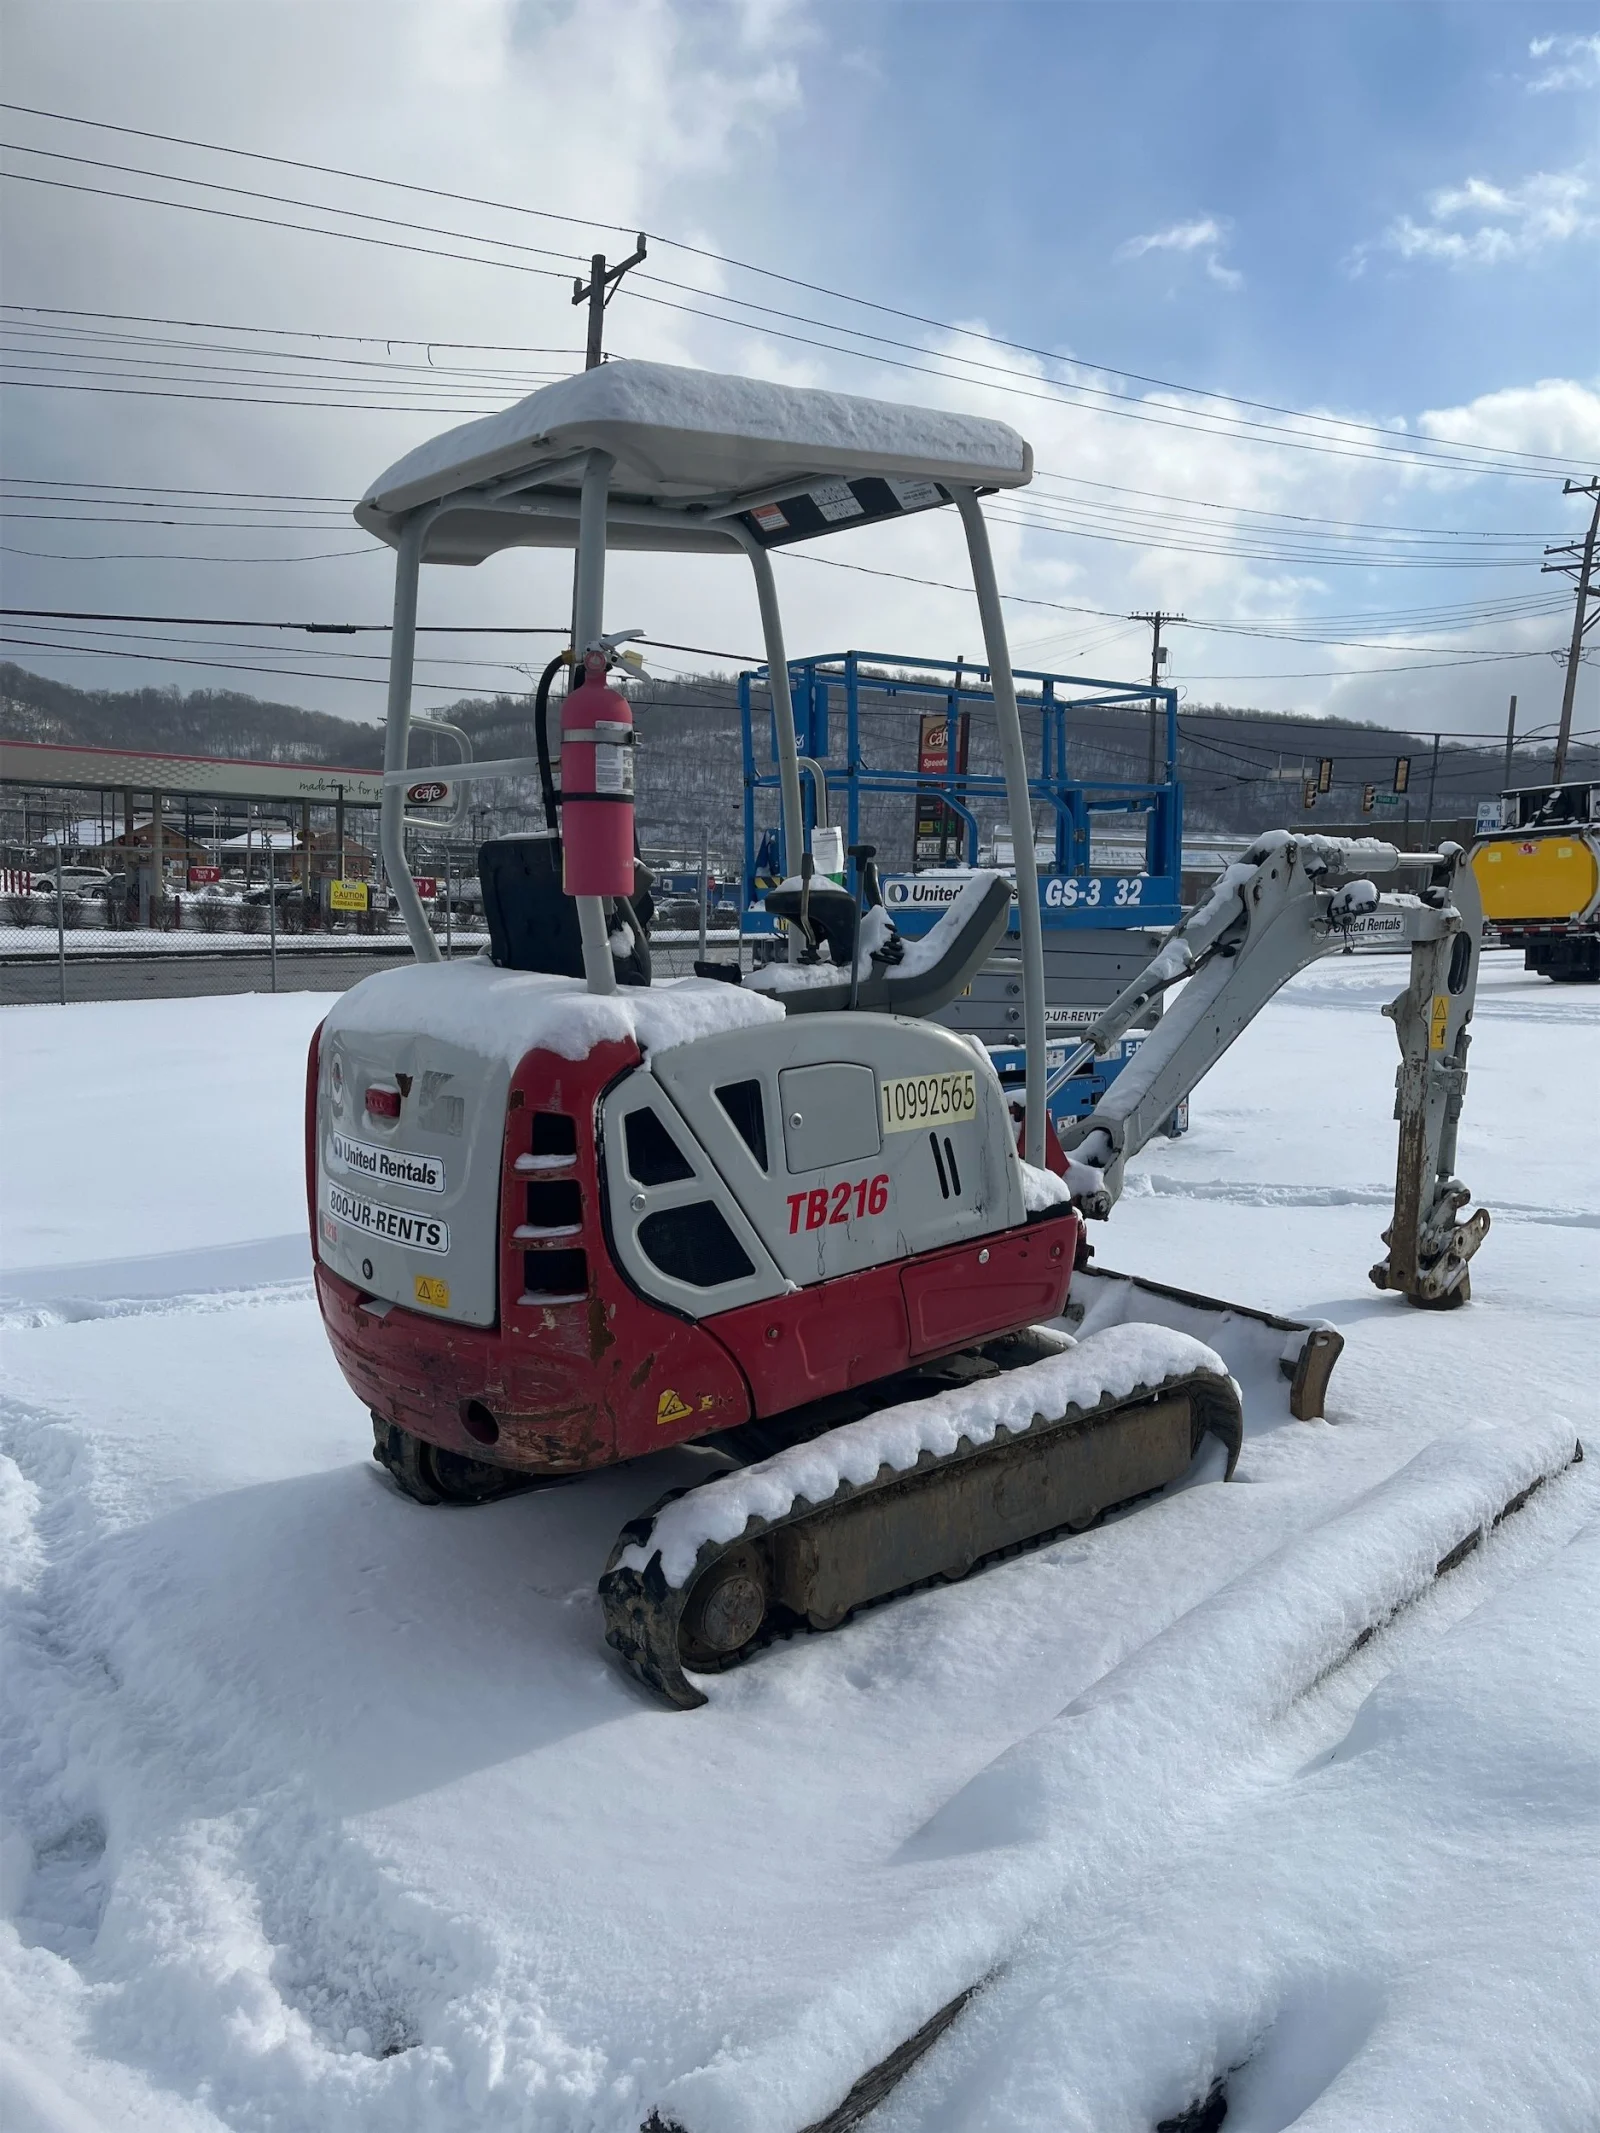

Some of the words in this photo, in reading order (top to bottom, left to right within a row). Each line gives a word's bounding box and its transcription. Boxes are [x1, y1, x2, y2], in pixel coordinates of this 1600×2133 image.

[923, 758, 948, 769] Speedw
[299, 777, 326, 792] made
[330, 778, 355, 793] frsh
[358, 781, 372, 795] for
[333, 890, 365, 900] CAUTION
[1045, 878, 1102, 907] GS-3
[1113, 878, 1143, 906] 32
[1367, 917, 1401, 931] Rentals
[883, 1075, 975, 1122] 10992565
[343, 1142, 377, 1171] United
[379, 1154, 437, 1185] Rentals
[330, 1190, 441, 1246] 800-UR-RENTS
[786, 1174, 890, 1235] TB216
